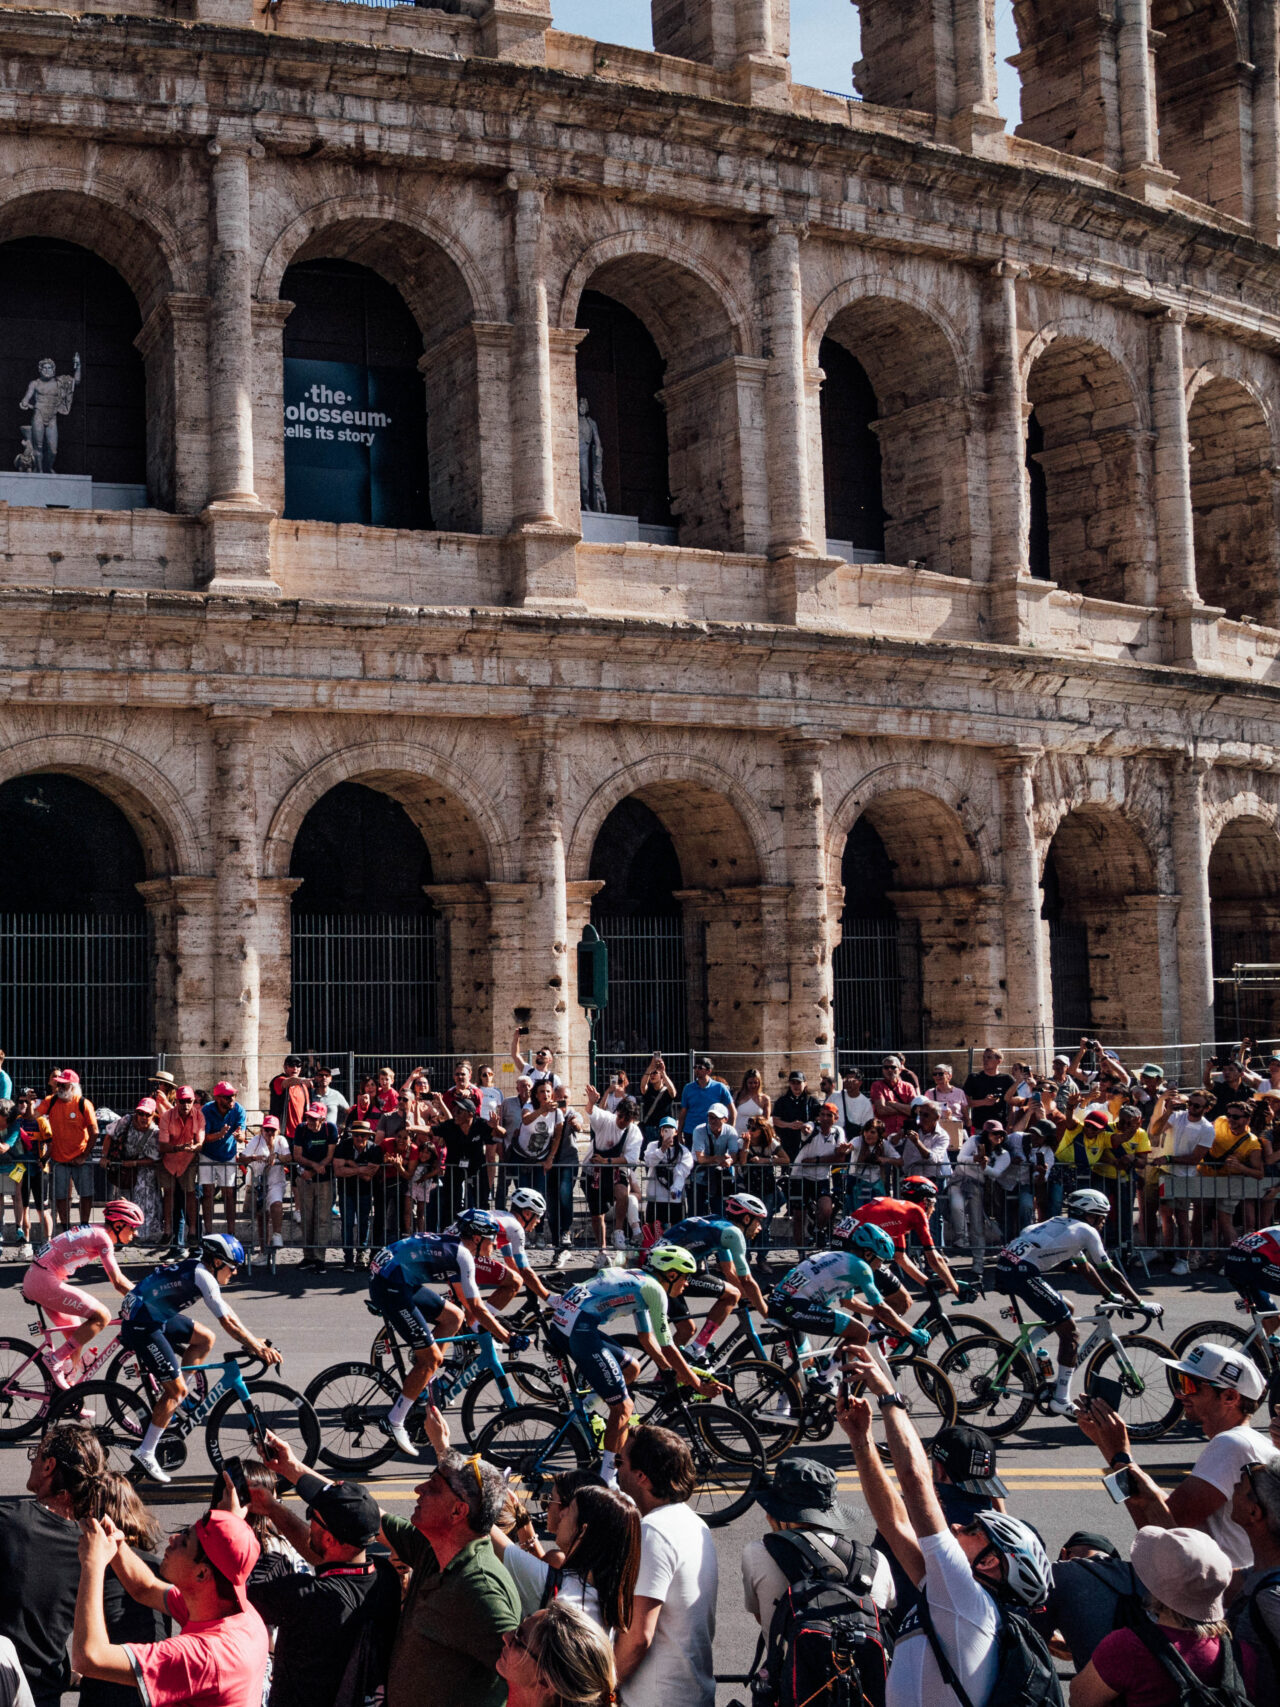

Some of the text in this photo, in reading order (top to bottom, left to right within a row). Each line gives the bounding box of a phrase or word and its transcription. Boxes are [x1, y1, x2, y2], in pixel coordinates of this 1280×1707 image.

[284, 402, 387, 427] olosseum
[315, 426, 335, 440] its
[337, 428, 376, 447] story
[1010, 1241, 1030, 1257] 35
[160, 1281, 183, 1291] FACTOR
[690, 1279, 723, 1292] DECATHLON
[63, 1297, 84, 1311] UAE
[569, 1288, 587, 1305] 93
[399, 1308, 418, 1331] ISRAEL
[1000, 1308, 1010, 1320] 35
[28, 1321, 40, 1337] 191
[147, 1343, 167, 1368] ISRAEL
[375, 1340, 387, 1357] 103
[775, 1343, 788, 1360] 201
[124, 1364, 137, 1381] 104
[547, 1364, 561, 1379] 93
[350, 1365, 400, 1399] BLACK
[533, 1366, 567, 1407] BLACK
[180, 1382, 229, 1440] FACTOR
[209, 1438, 223, 1463] INC
